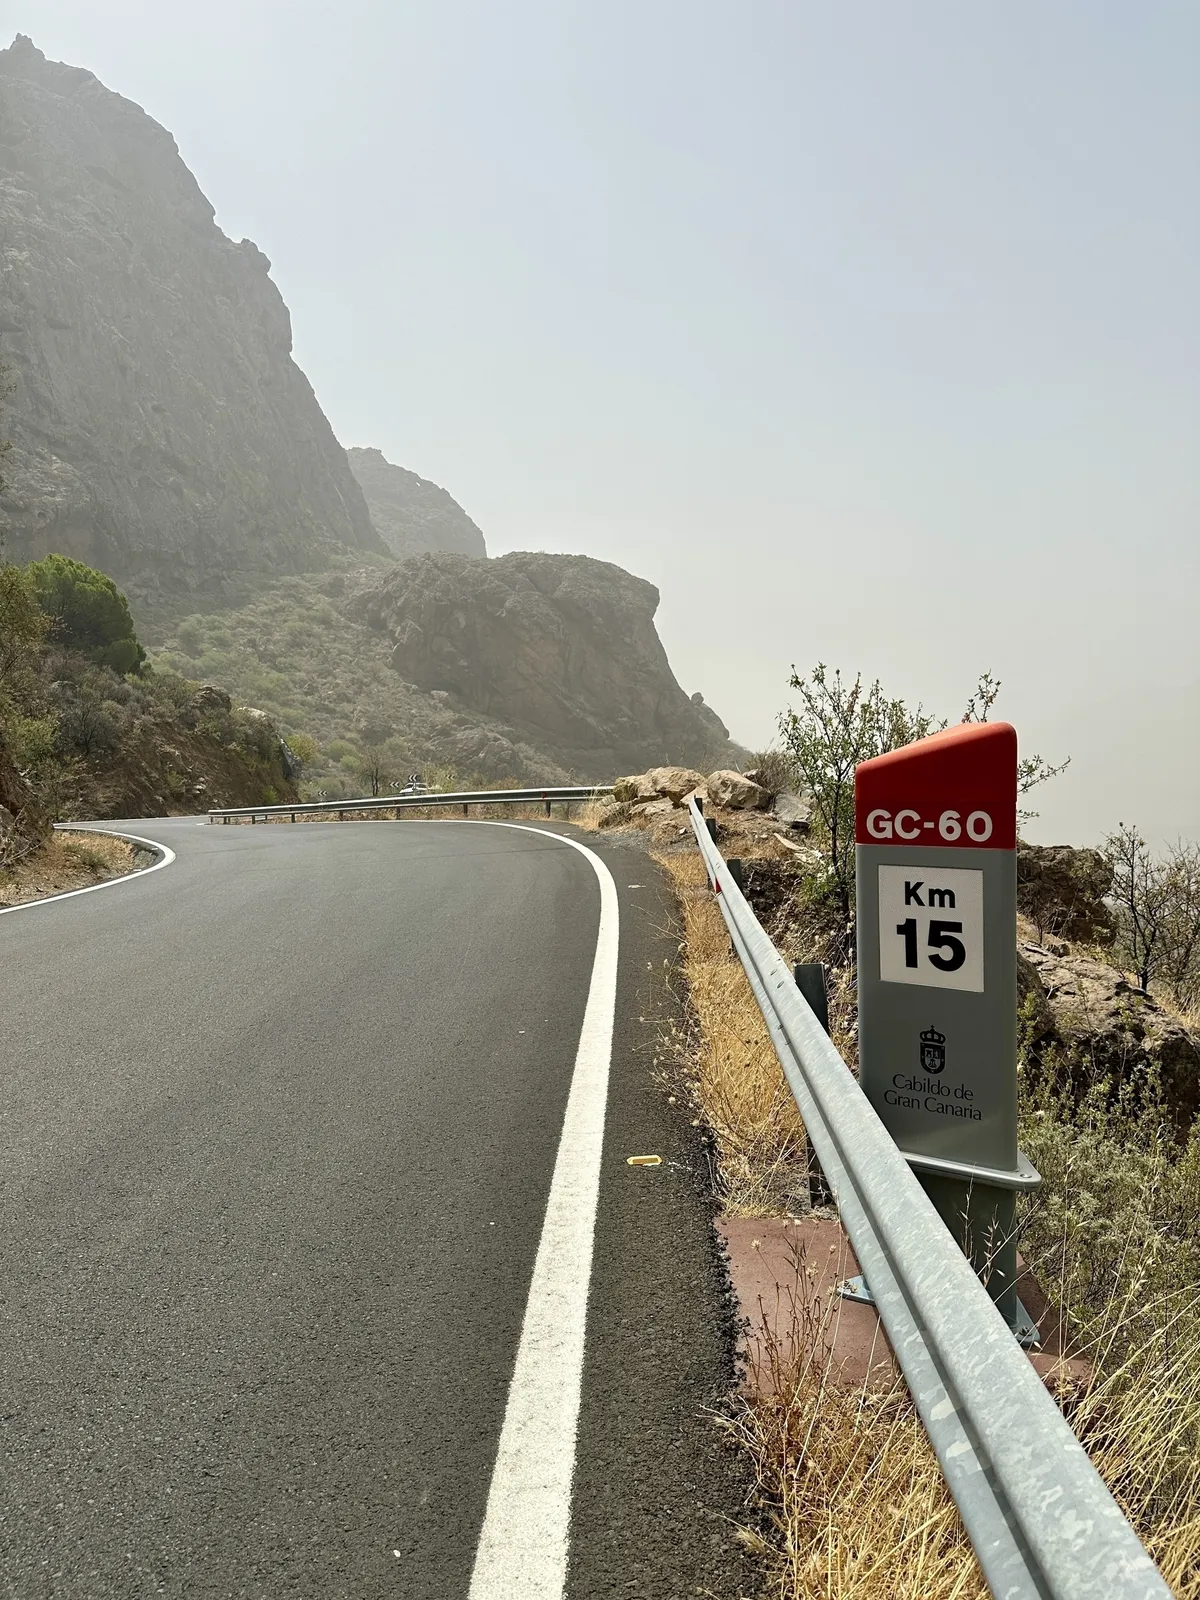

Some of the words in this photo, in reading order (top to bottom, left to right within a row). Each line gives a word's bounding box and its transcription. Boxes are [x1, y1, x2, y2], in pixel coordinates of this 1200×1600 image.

[866, 809, 993, 842] GC-60
[904, 881, 956, 909] Km
[896, 918, 966, 972] 15
[892, 1073, 950, 1097] Cabildo
[954, 1083, 974, 1101] de
[884, 1089, 920, 1109] Gran
[924, 1096, 982, 1121] Canaria
